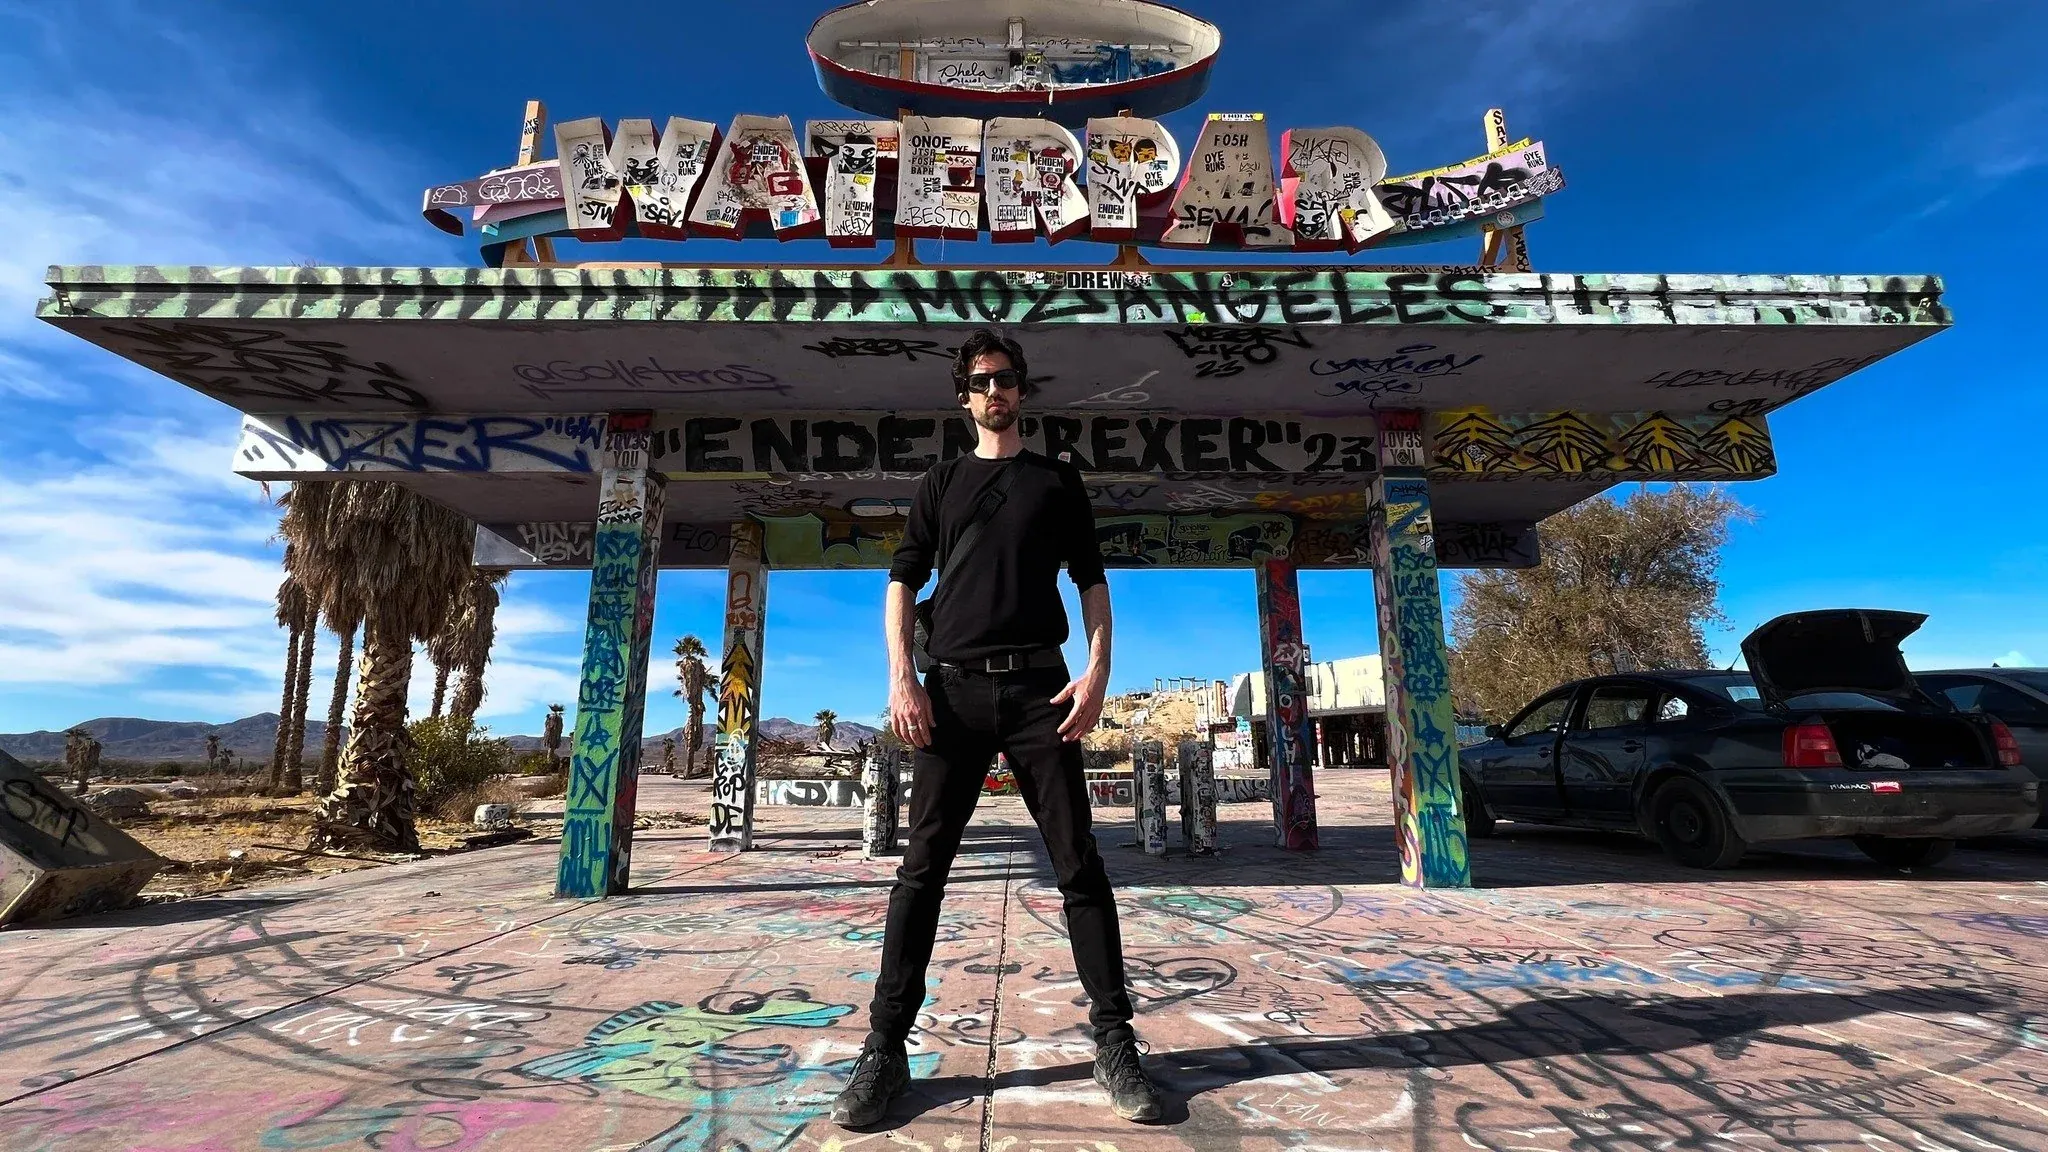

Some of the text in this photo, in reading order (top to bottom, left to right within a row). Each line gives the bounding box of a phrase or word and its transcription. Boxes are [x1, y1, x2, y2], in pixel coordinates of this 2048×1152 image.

[911, 135, 952, 149] ONOE
[991, 146, 1010, 154] OYE
[1524, 150, 1541, 160] OYE
[990, 153, 1010, 162] RUNS
[1204, 150, 1225, 163] OYE
[677, 160, 697, 168] OYE
[1037, 157, 1064, 168] ENDEM
[1205, 160, 1226, 173] RUNS
[1526, 158, 1545, 169] RUNS
[677, 168, 697, 176] RUNS
[910, 166, 935, 175] BAPH
[1144, 171, 1163, 180] OYE
[1145, 178, 1164, 188] RUNS
[1098, 203, 1125, 215] ENDEM
[908, 206, 970, 227] BESTO
[1066, 271, 1123, 289] DREW
[1194, 359, 1246, 378] 23
[1381, 431, 1422, 448] LOV3S
[1302, 432, 1377, 472] 23
[613, 450, 640, 468] YOU
